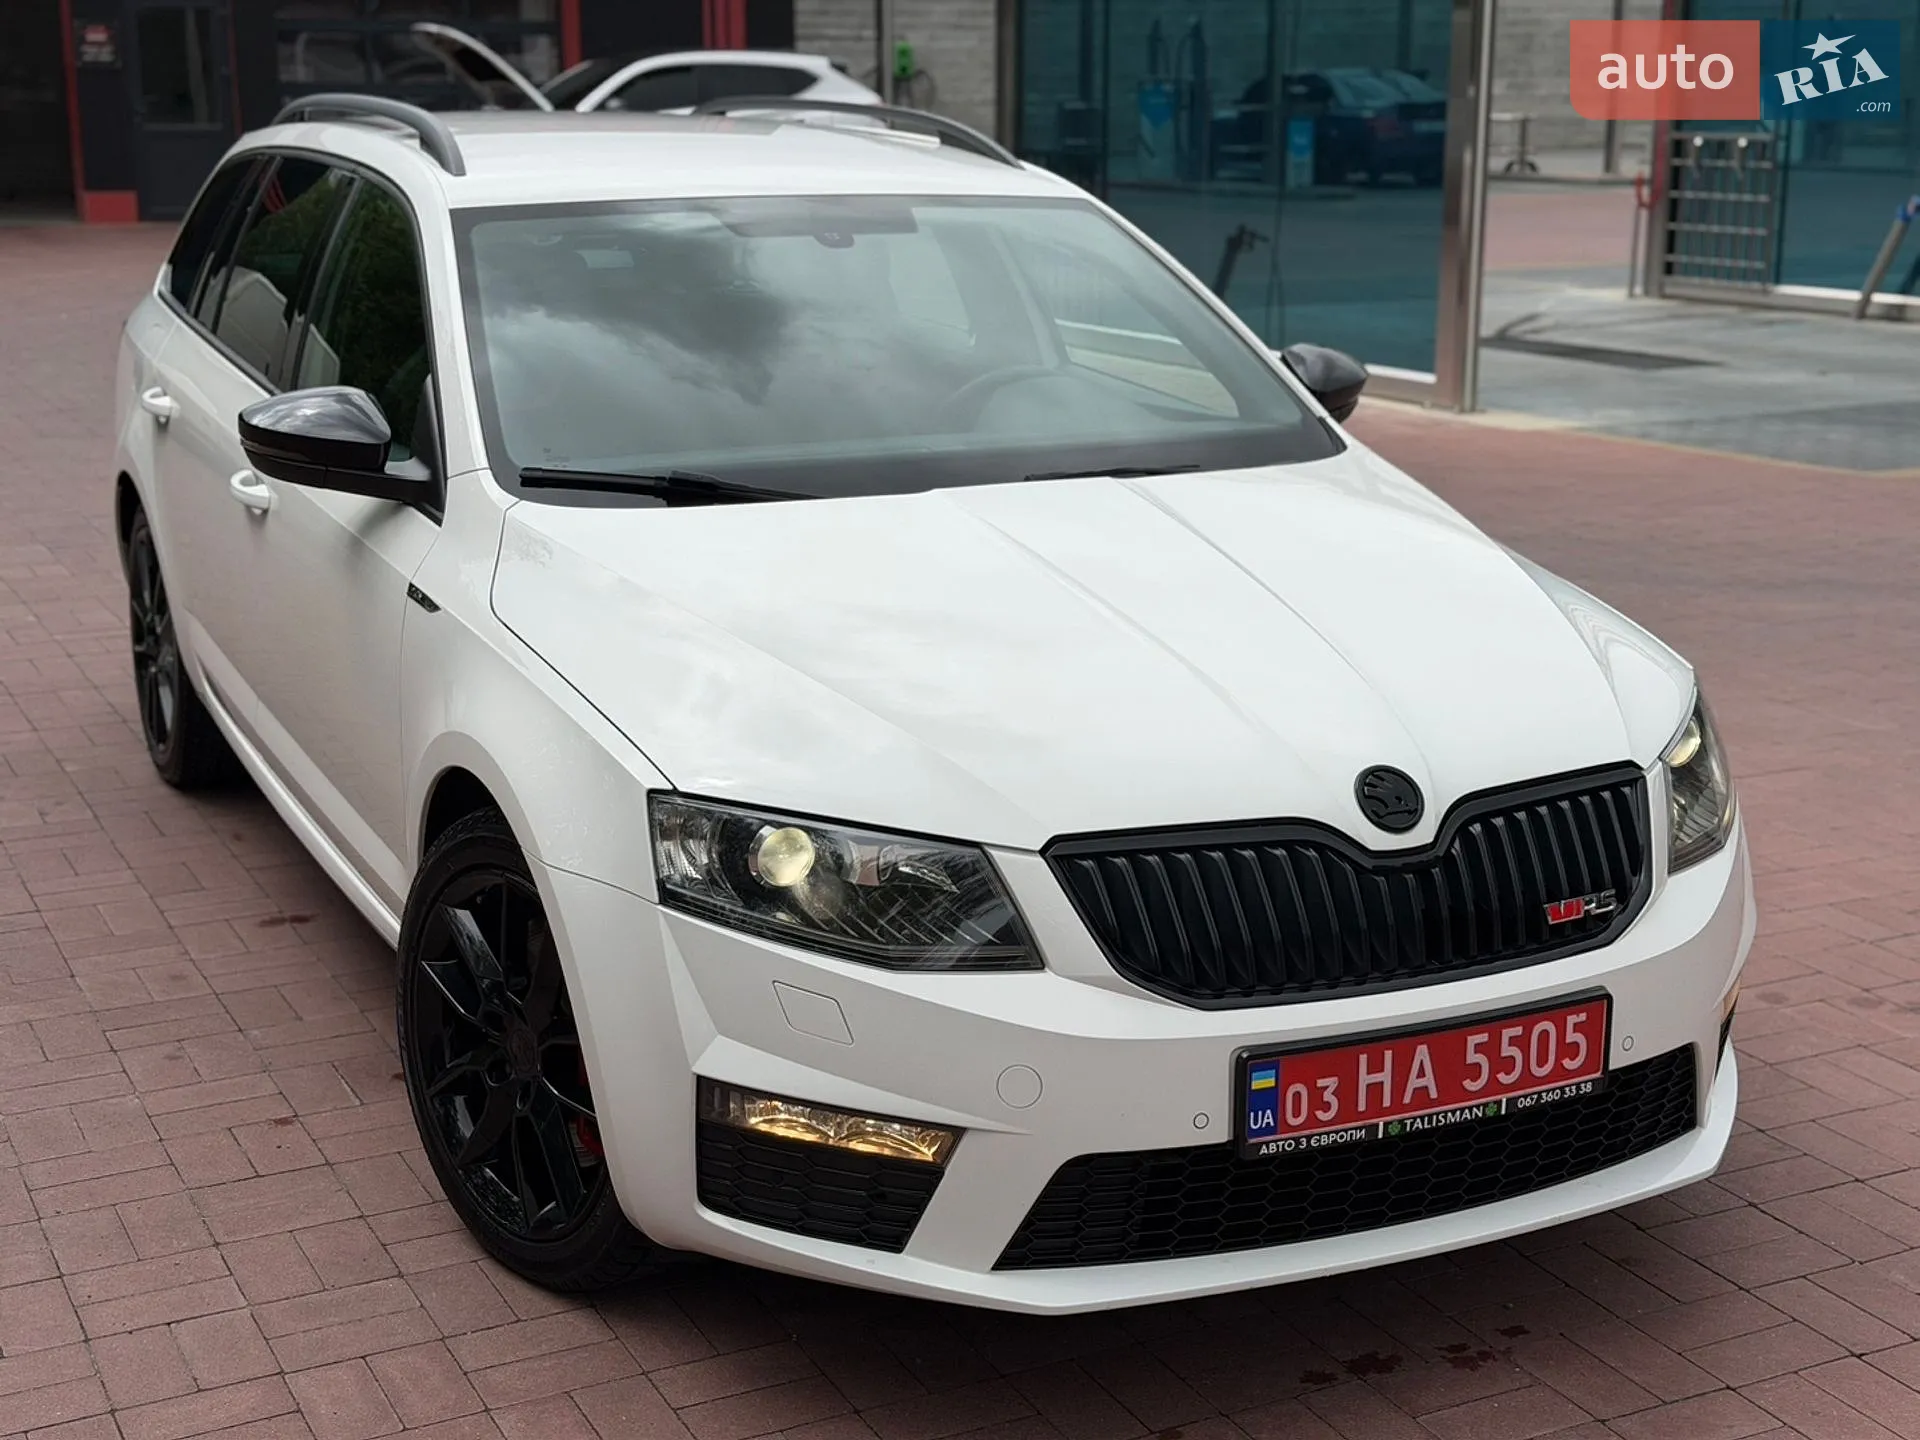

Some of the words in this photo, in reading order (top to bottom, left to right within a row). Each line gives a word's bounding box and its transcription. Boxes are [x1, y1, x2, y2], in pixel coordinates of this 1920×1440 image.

[1285, 1077, 1339, 1126] 03
[1357, 1045, 1438, 1112] HA
[1462, 1012, 1588, 1092] 5505
[1517, 1095, 1537, 1109] 067
[1541, 1090, 1561, 1103] 360
[1563, 1085, 1576, 1098] 33
[1579, 1081, 1593, 1094] 38
[1250, 1109, 1275, 1129] UA
[1404, 1106, 1483, 1132] TALISMAN
[1259, 1139, 1295, 1155] АВТО
[1310, 1128, 1366, 1147] ЄВРОПИ
